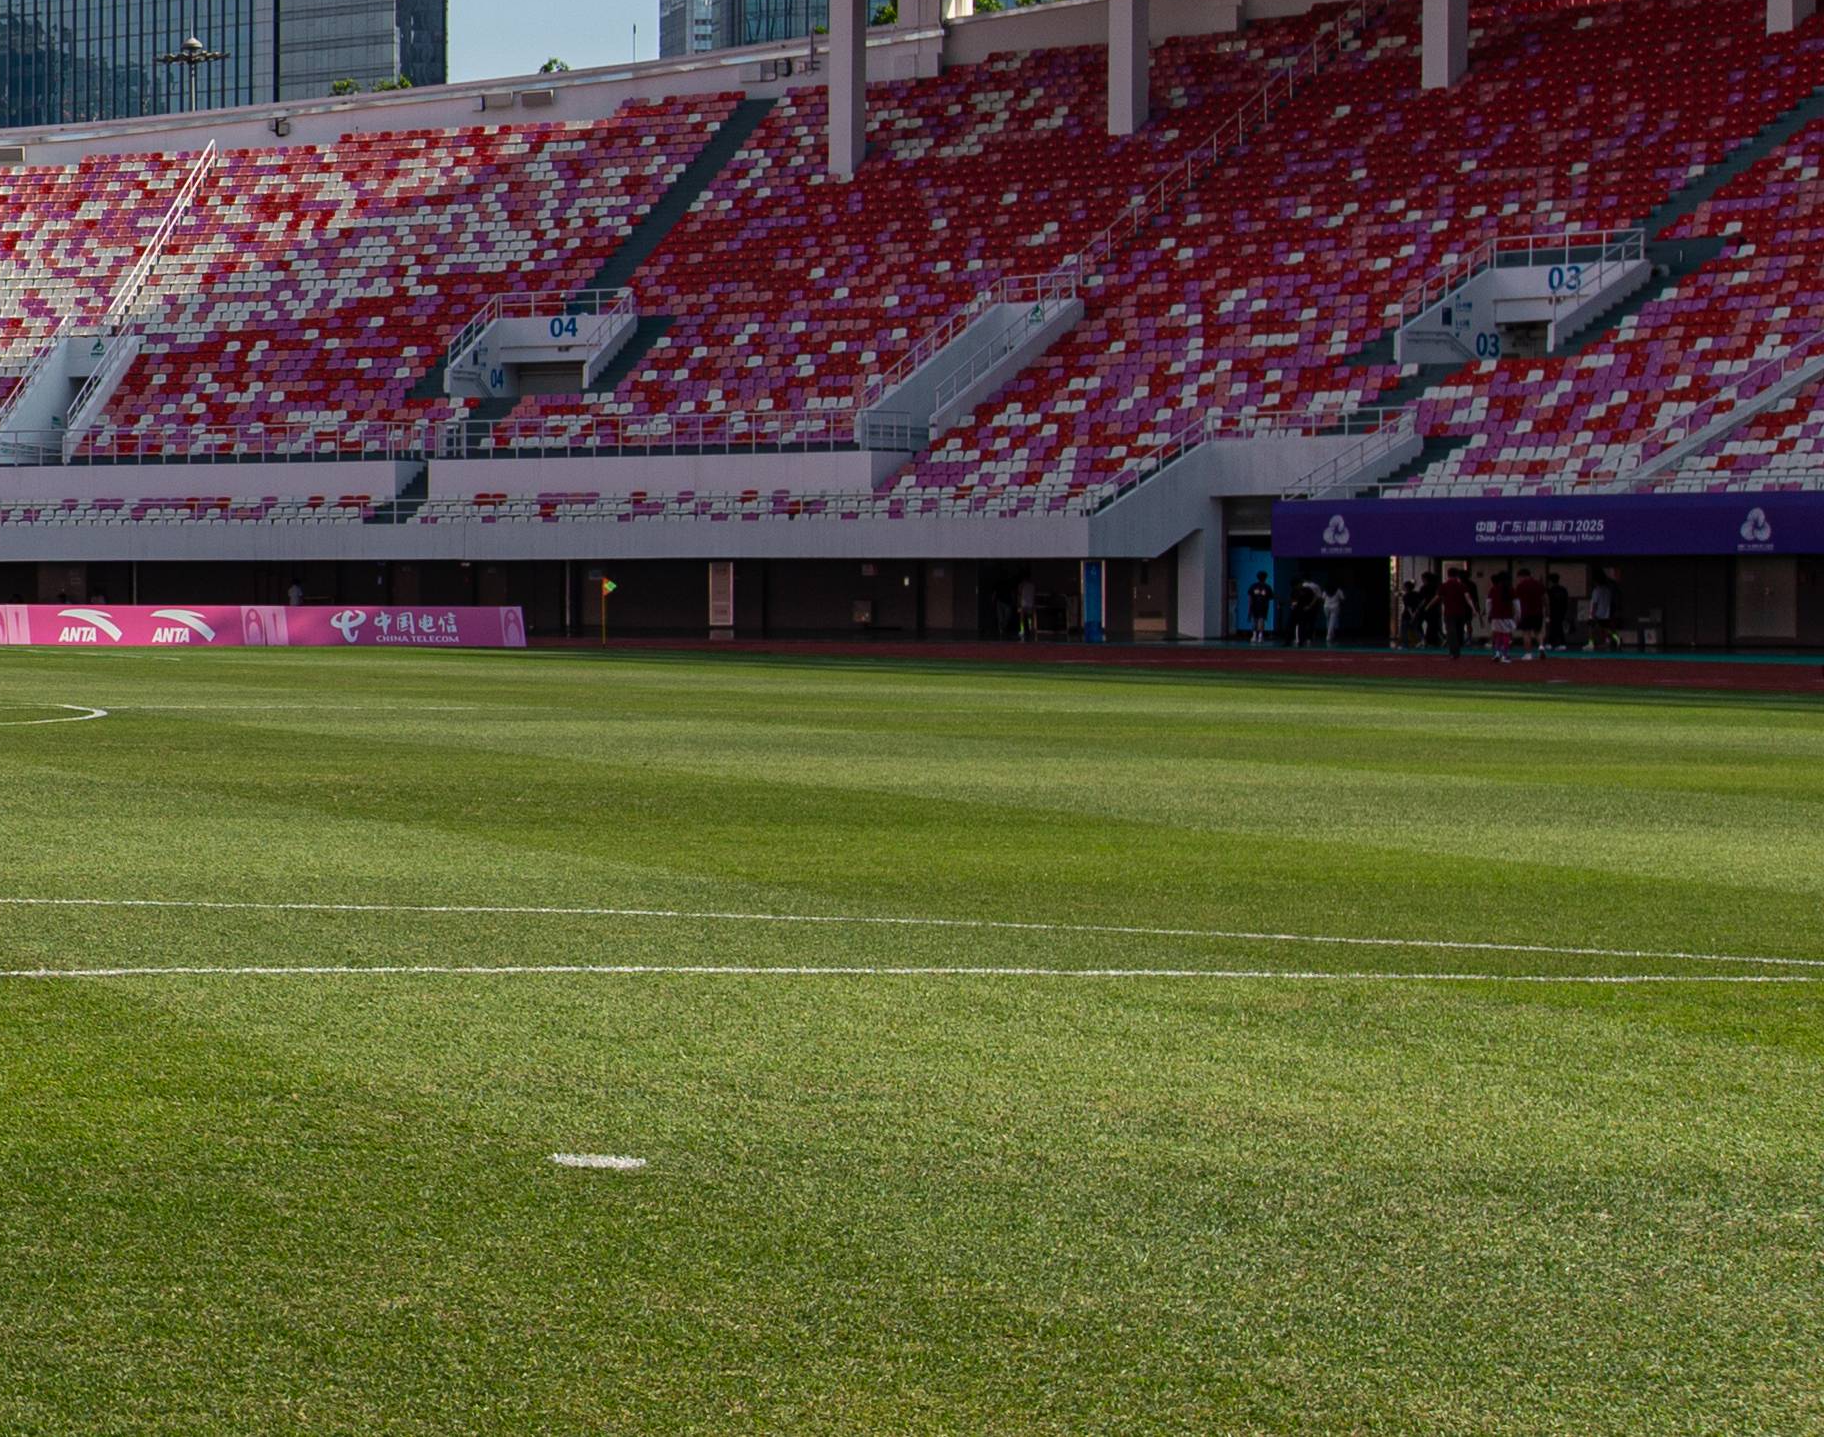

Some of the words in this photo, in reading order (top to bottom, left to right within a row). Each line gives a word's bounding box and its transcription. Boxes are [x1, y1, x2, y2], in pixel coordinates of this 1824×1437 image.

[1548, 266, 1581, 291] 03
[550, 318, 577, 338] 04
[1476, 333, 1500, 357] 03
[491, 369, 504, 390] 04
[1576, 520, 1604, 532] 2025
[374, 610, 458, 634] 中国电信
[58, 627, 97, 642] ANTA
[152, 627, 190, 643] ANTA
